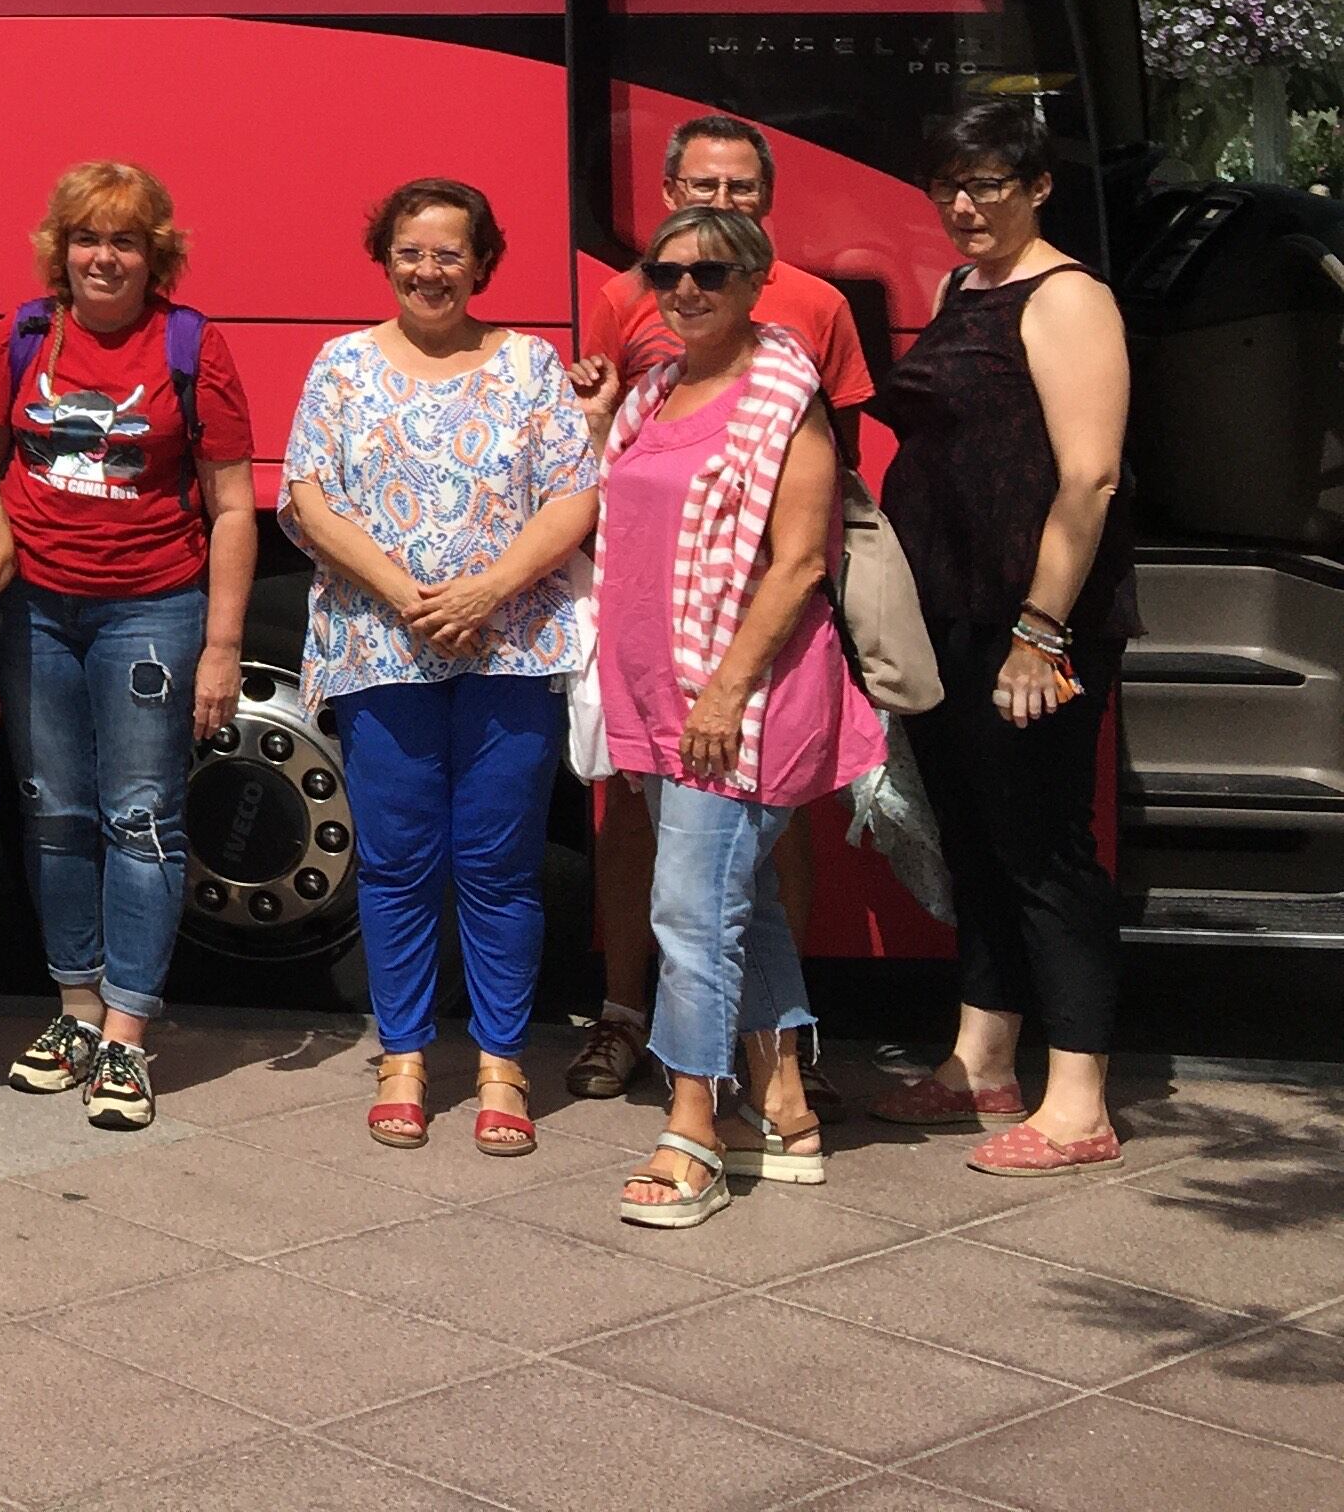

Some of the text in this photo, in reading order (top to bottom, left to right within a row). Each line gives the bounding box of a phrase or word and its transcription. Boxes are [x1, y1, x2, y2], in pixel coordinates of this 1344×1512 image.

[907, 61, 978, 75] PRO
[67, 478, 109, 498] CANAL
[223, 780, 265, 863] IVECO
